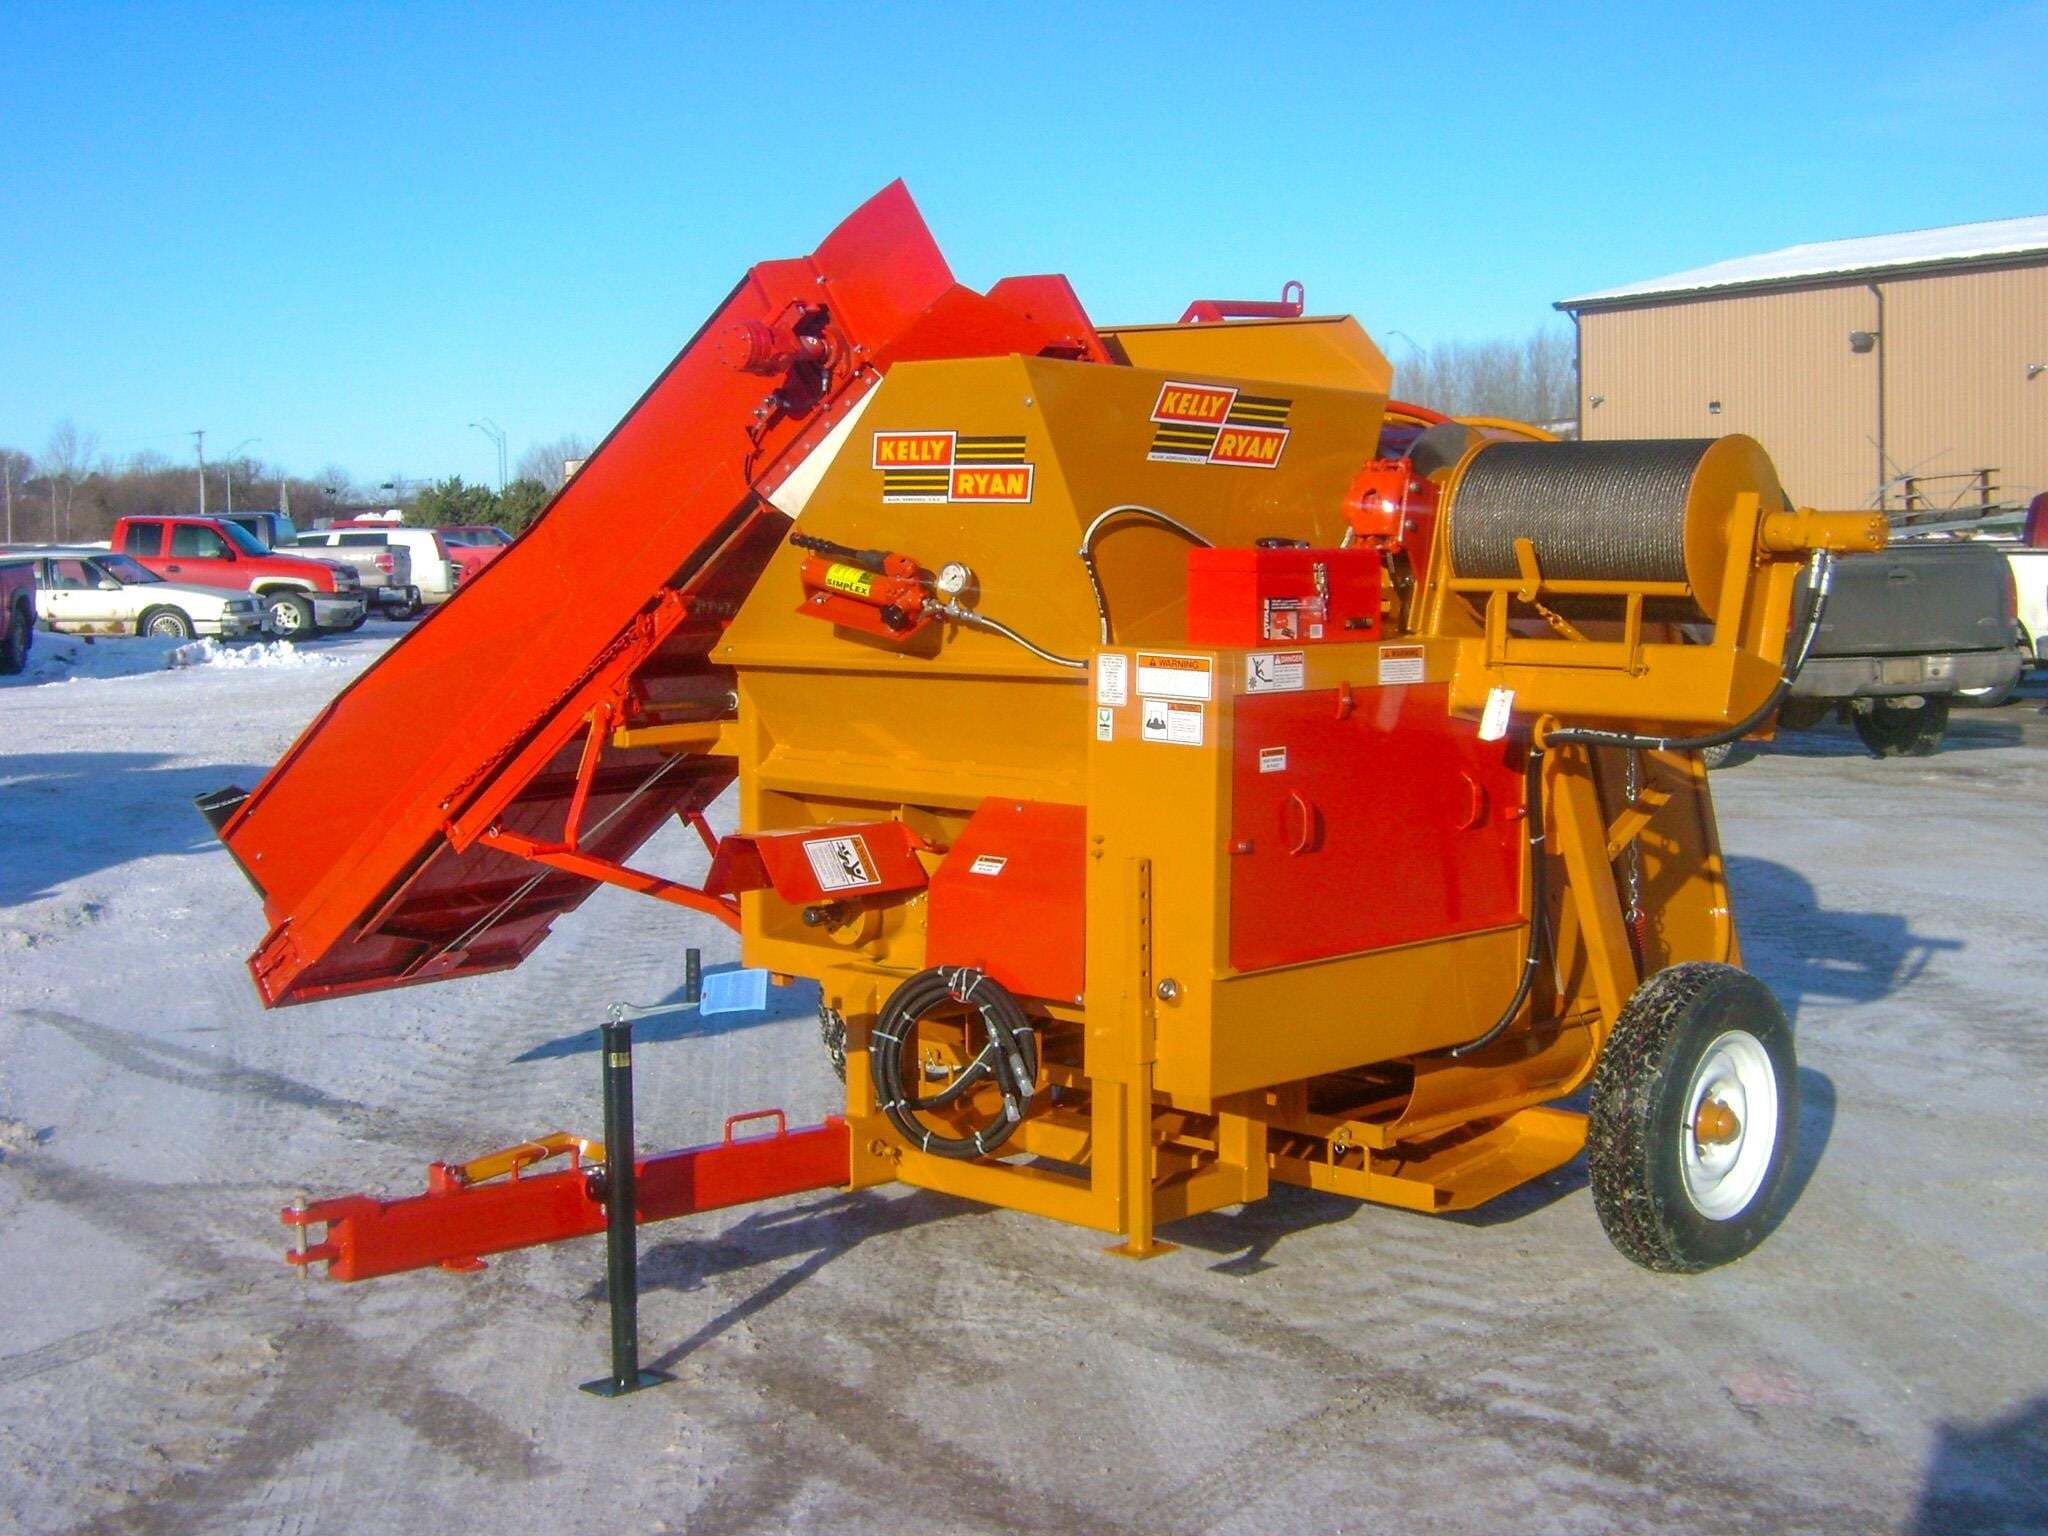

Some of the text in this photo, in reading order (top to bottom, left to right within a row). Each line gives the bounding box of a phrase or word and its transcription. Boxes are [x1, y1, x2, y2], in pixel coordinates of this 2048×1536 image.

[1161, 391, 1226, 417] KELLY
[881, 440, 945, 461] KELLY
[1218, 434, 1279, 459] RYAN
[958, 473, 1024, 495] RYAN
[827, 578, 868, 595] SIMPLEX
[1159, 658, 1200, 670] WARNING
